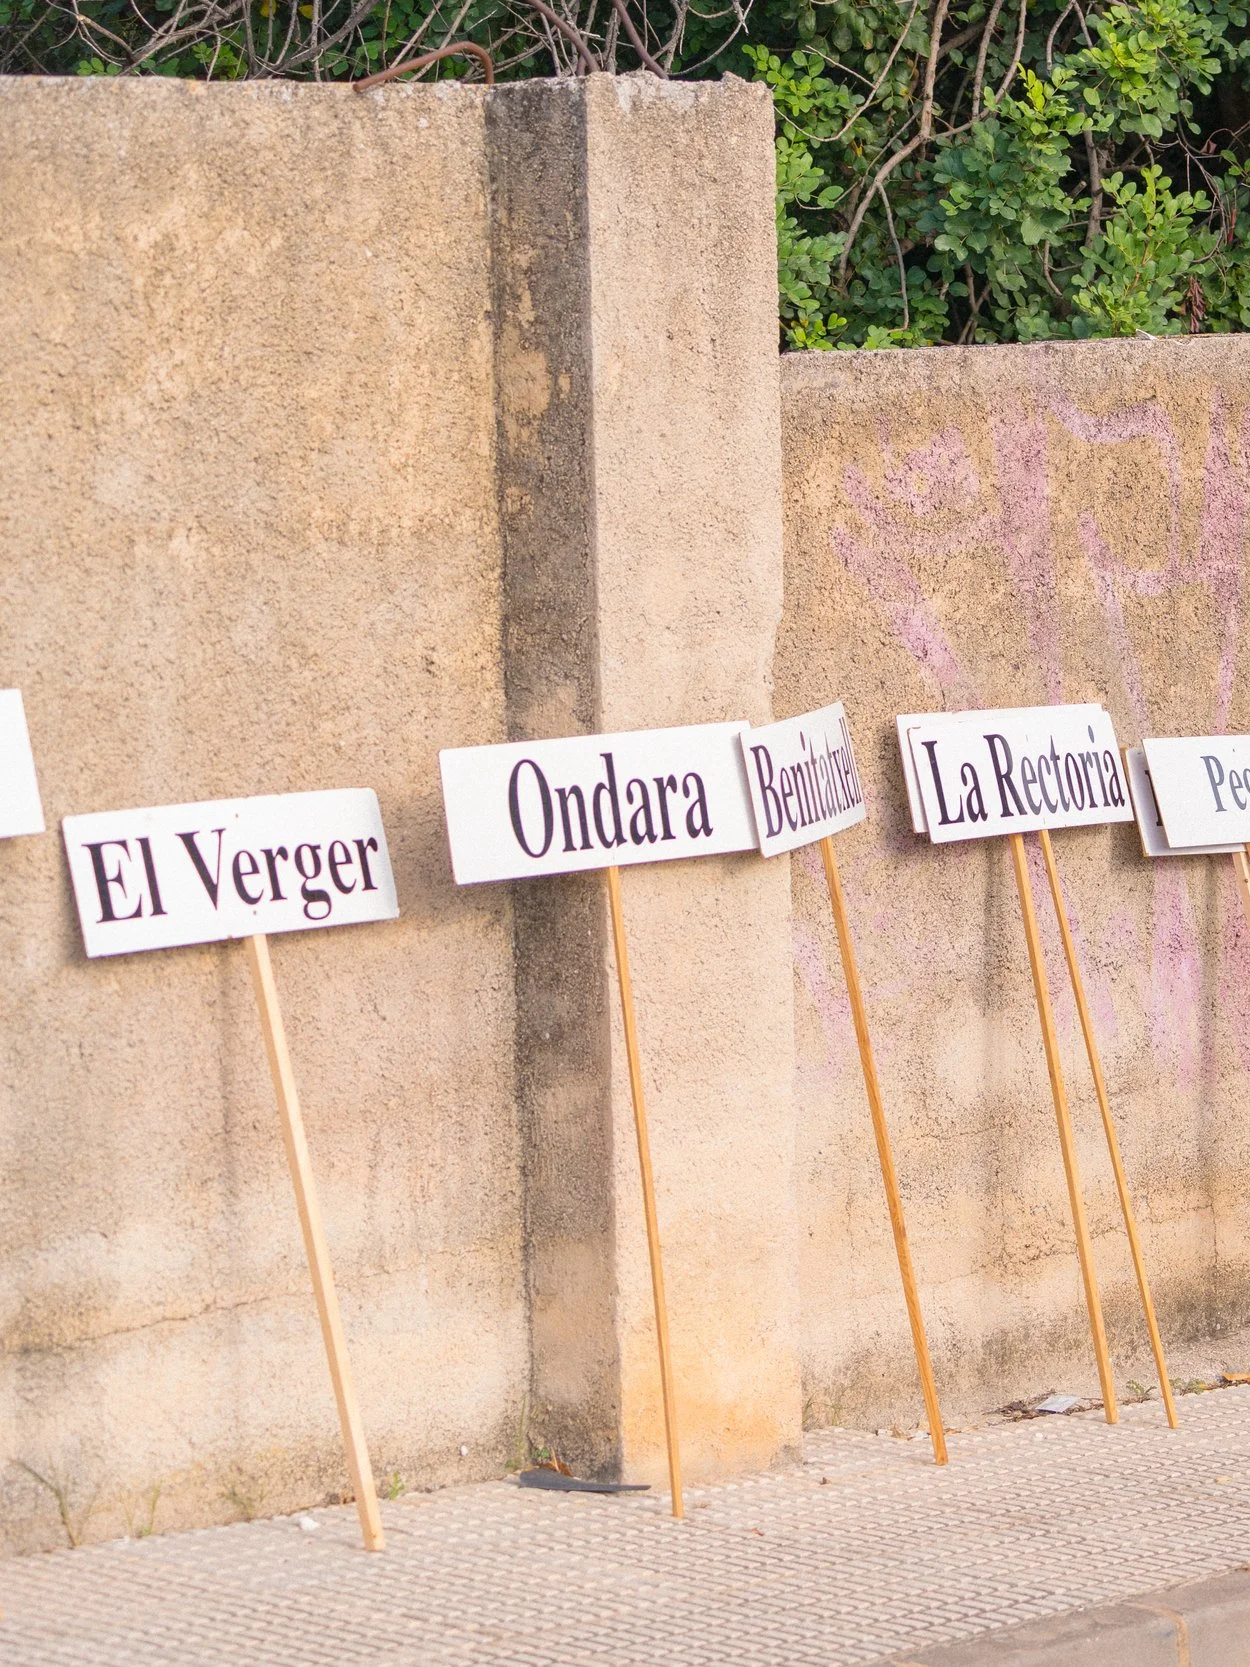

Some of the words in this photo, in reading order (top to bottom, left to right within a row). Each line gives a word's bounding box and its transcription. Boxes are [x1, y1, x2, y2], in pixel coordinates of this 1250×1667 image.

[508, 752, 714, 859] Ondara
[750, 716, 862, 838] Benitatxell
[921, 740, 988, 826] La
[983, 725, 1126, 817] Rectoria
[81, 837, 168, 924] El
[175, 828, 379, 920] Verger
